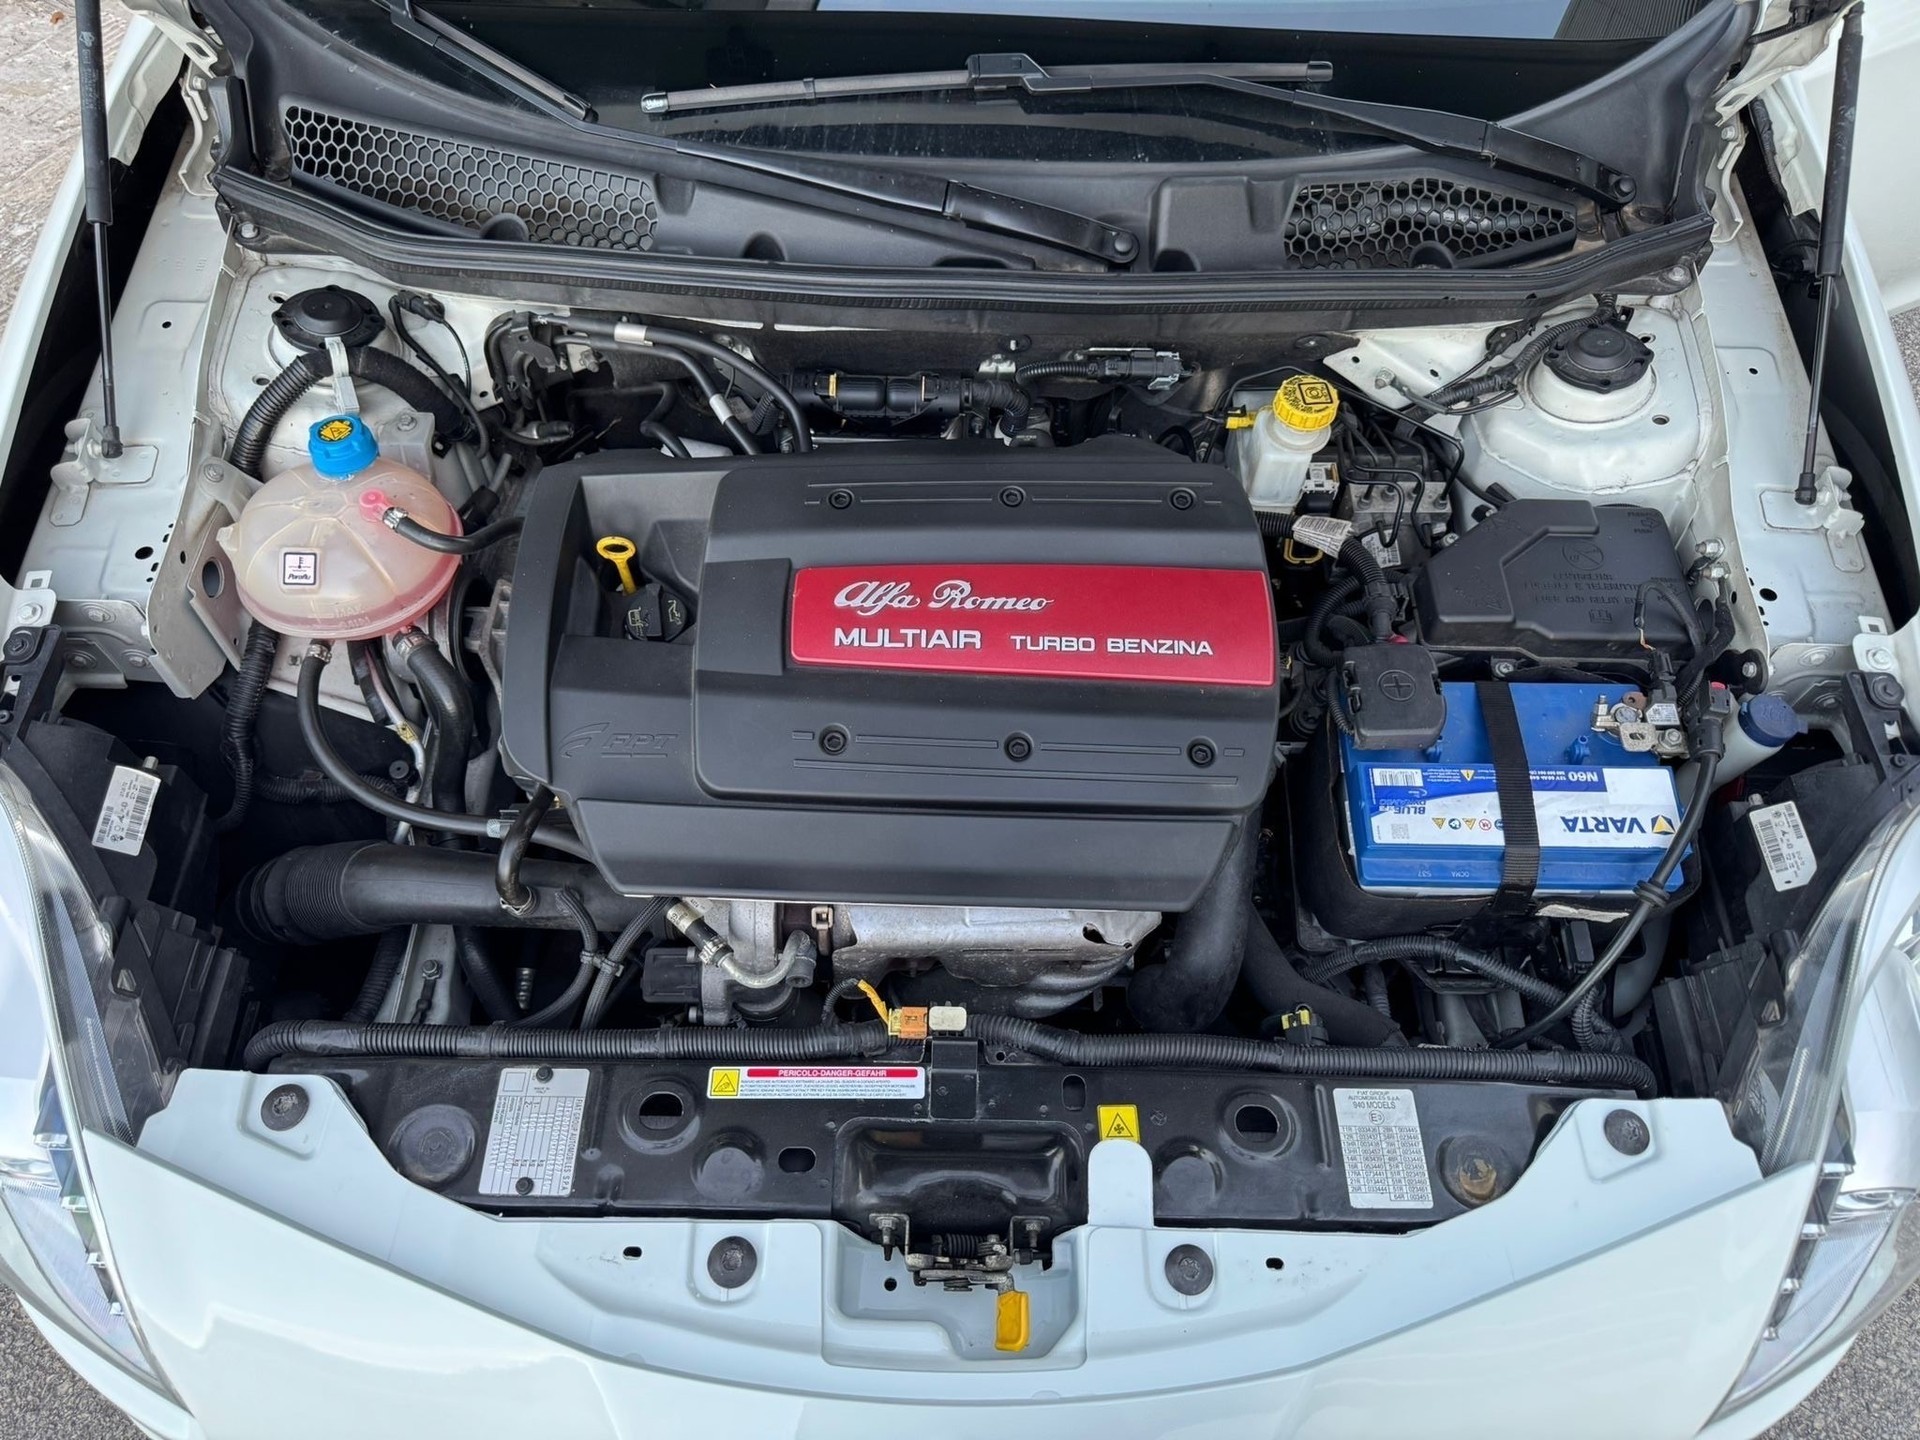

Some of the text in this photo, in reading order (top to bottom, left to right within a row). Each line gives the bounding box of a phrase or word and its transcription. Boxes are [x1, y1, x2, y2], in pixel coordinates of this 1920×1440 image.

[834, 579, 1053, 615] Alfa Romeo
[834, 627, 1214, 656] MULTIAIR TURBO BENZINA
[1568, 770, 1599, 782] N60
[1393, 806, 1426, 815] BLUE
[1560, 816, 1646, 834] VARTA
[778, 1069, 887, 1078] PERICOLO-DANGER-GEFAHR
[574, 1099, 582, 1111] FIAT
[571, 1112, 580, 1132] GROUP
[564, 1133, 578, 1173] AUTOMOBILES
